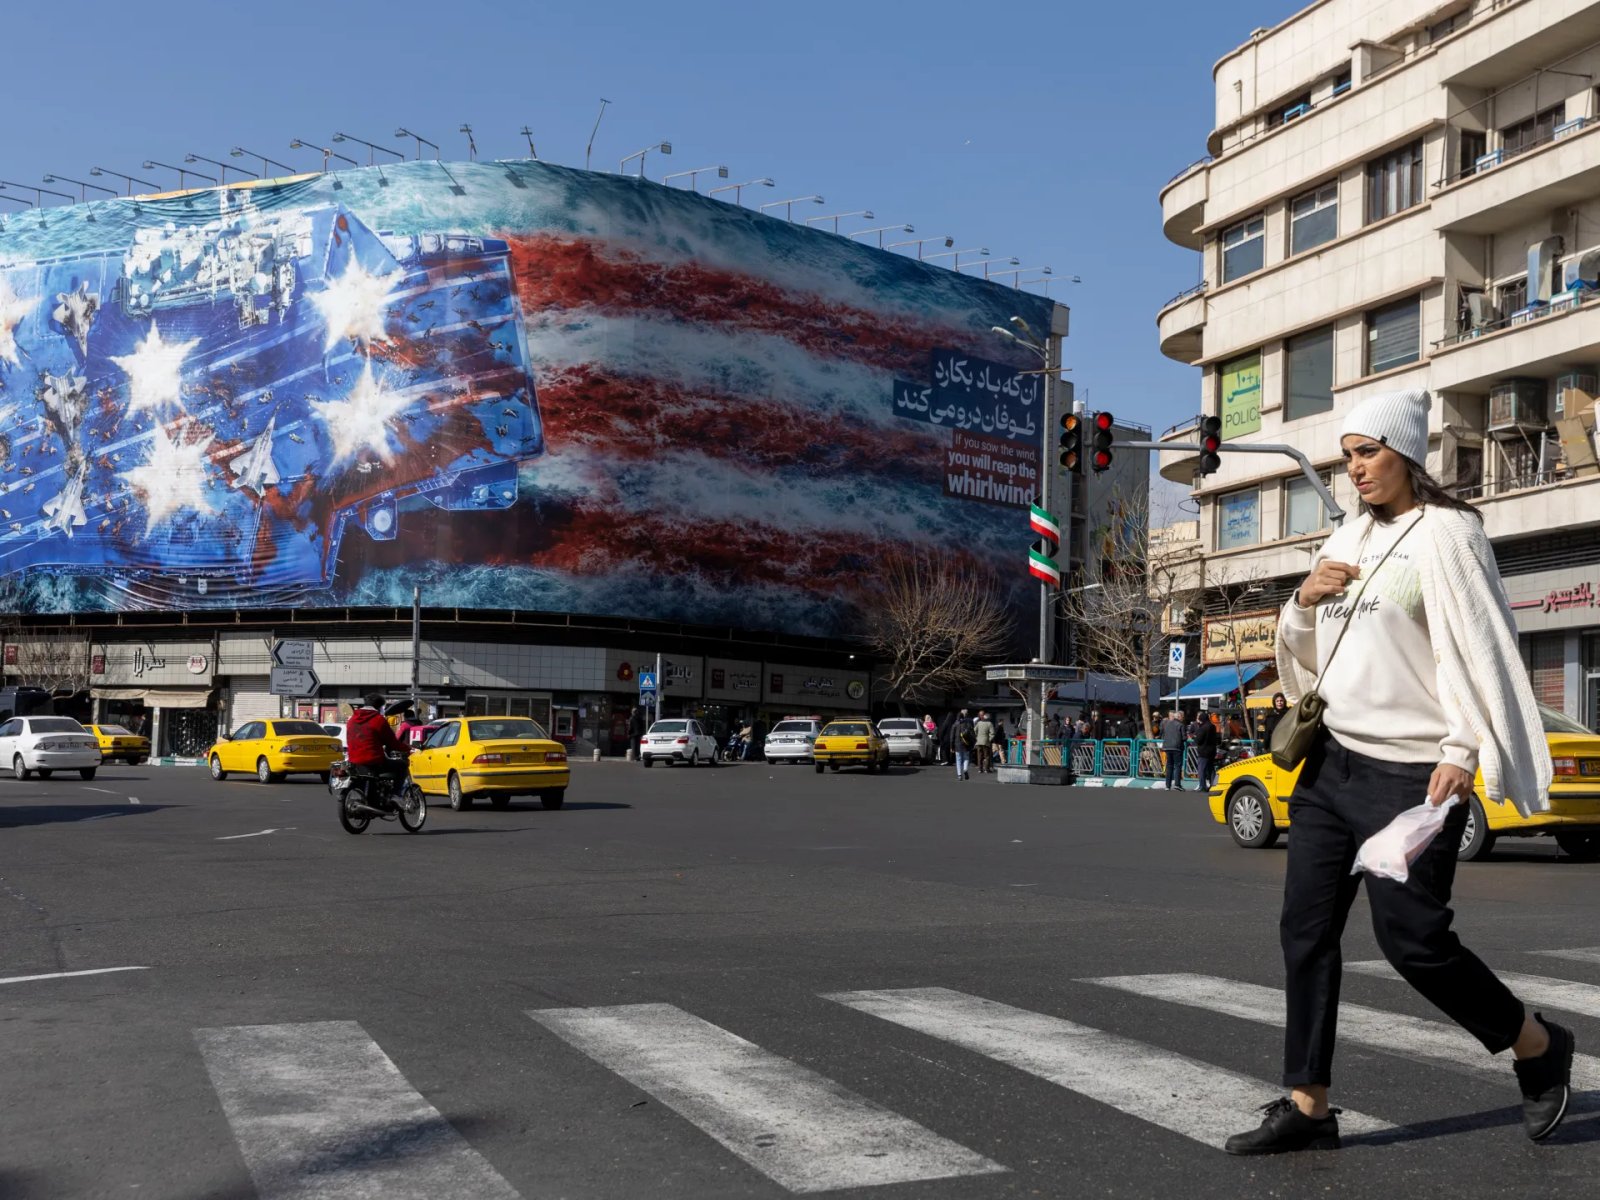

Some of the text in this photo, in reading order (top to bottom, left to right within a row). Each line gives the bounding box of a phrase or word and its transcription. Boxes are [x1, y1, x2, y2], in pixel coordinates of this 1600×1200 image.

[935, 357, 1040, 406] آن که باد بکارد
[955, 407, 982, 430] درو
[981, 403, 1036, 440] طوفان
[1225, 405, 1261, 429] POLICE
[955, 433, 1037, 463] If you sow the wind,
[948, 451, 1036, 480] you will reap the
[947, 469, 1035, 506] whirlwind
[669, 665, 693, 684] بانک
